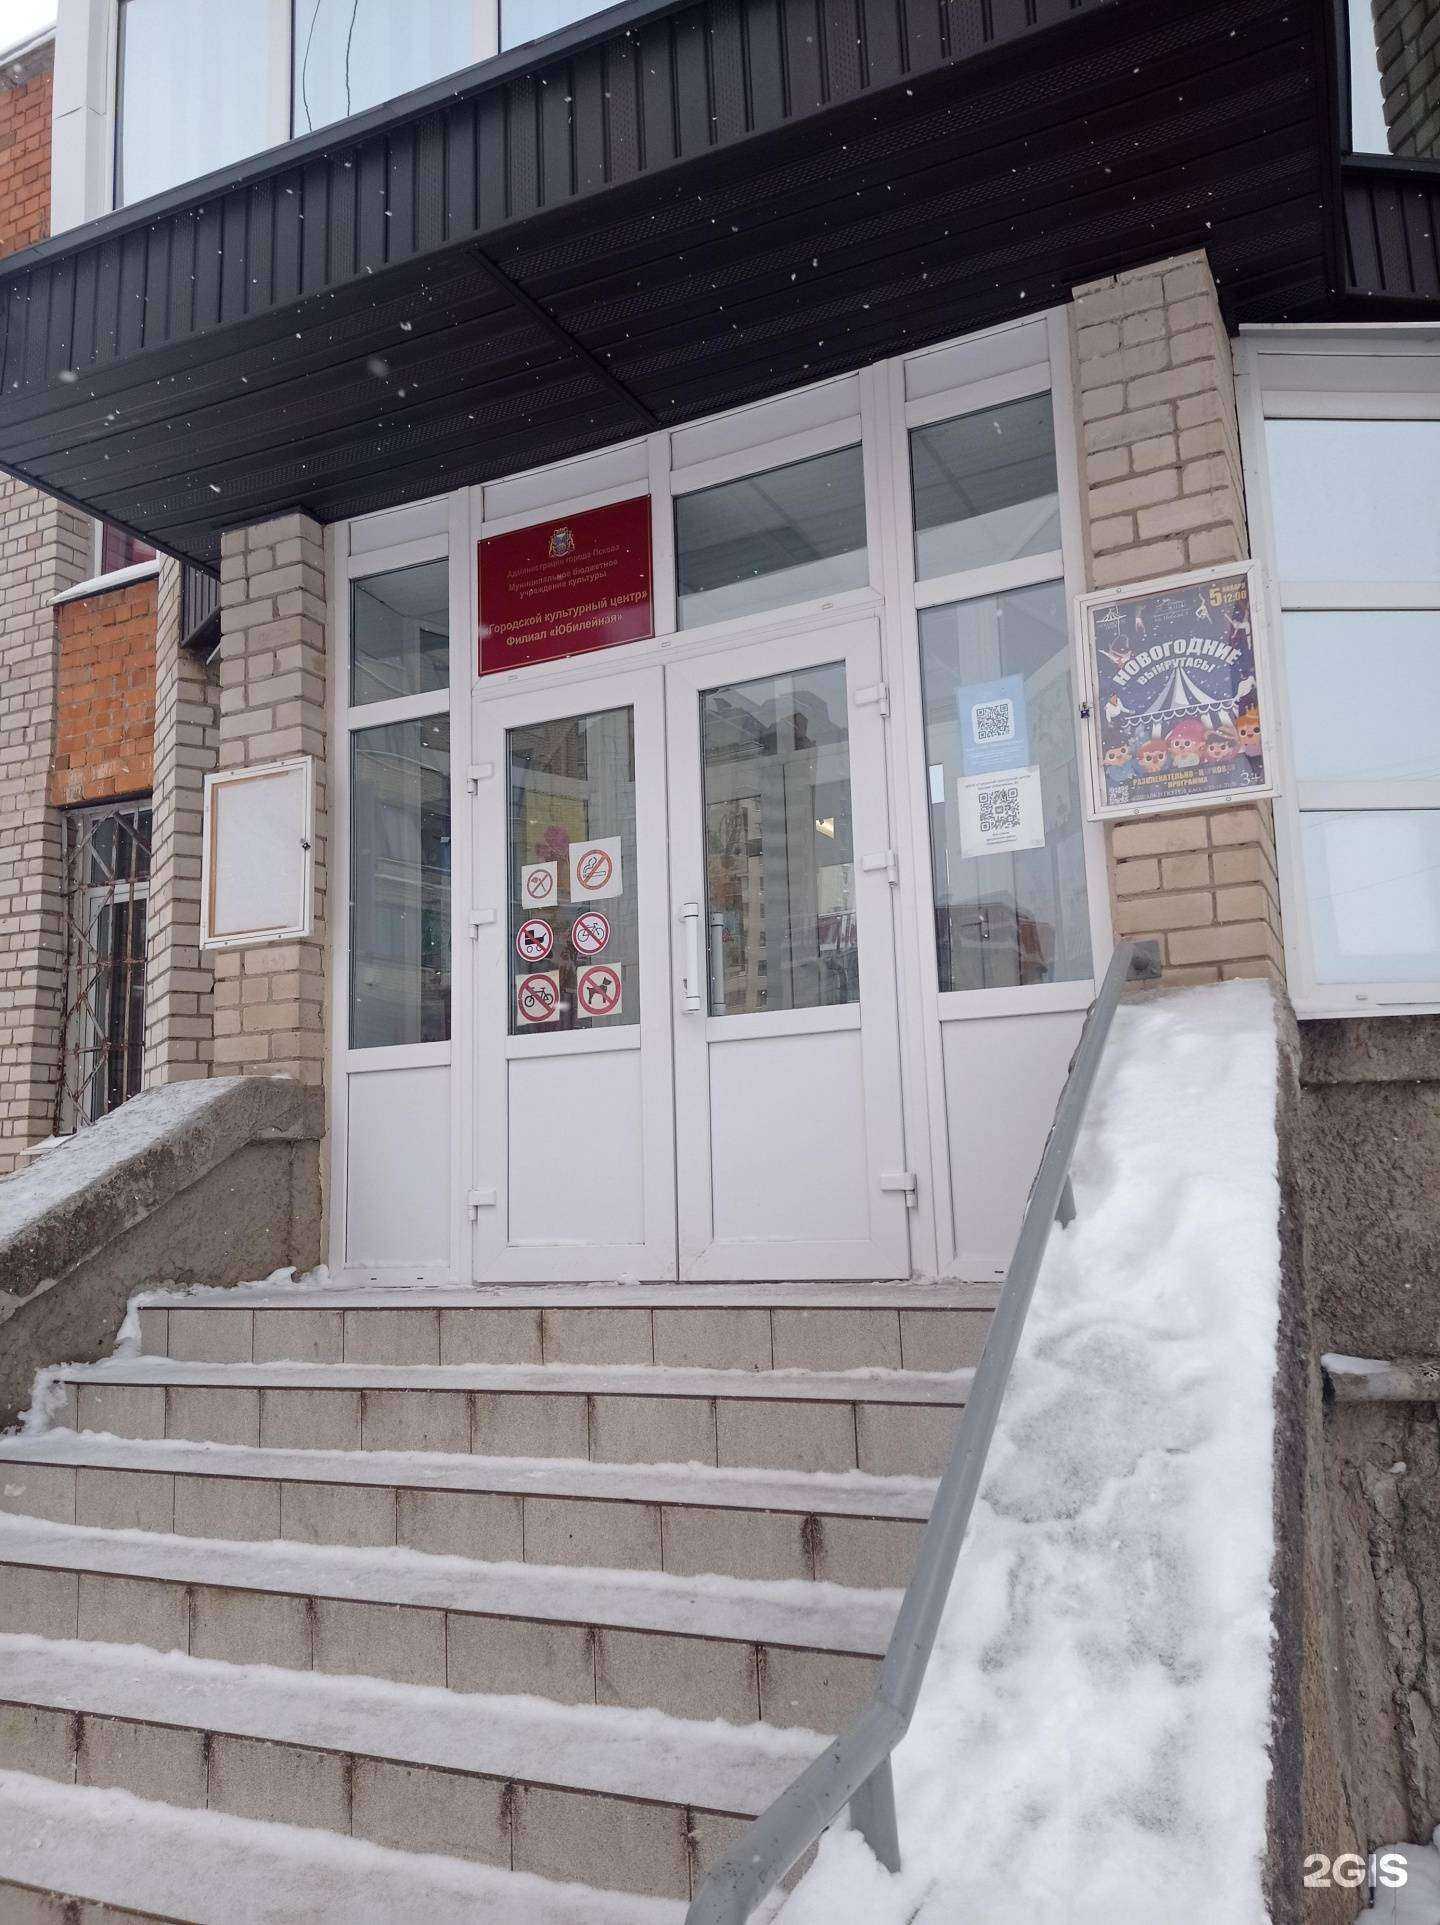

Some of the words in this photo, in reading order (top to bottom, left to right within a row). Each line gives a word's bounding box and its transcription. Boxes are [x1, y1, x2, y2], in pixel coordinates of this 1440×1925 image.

[544, 599, 608, 622] культурный
[610, 590, 648, 606] центр»
[1209, 587, 1222, 607] 5
[1223, 590, 1247, 603] 12:00
[506, 630, 547, 646] Филиал
[549, 613, 623, 636] «Юбилейная»
[1112, 637, 1242, 686] НОВОГОДНИЕ
[1137, 657, 1216, 686] ВЫКРУТАСЫ
